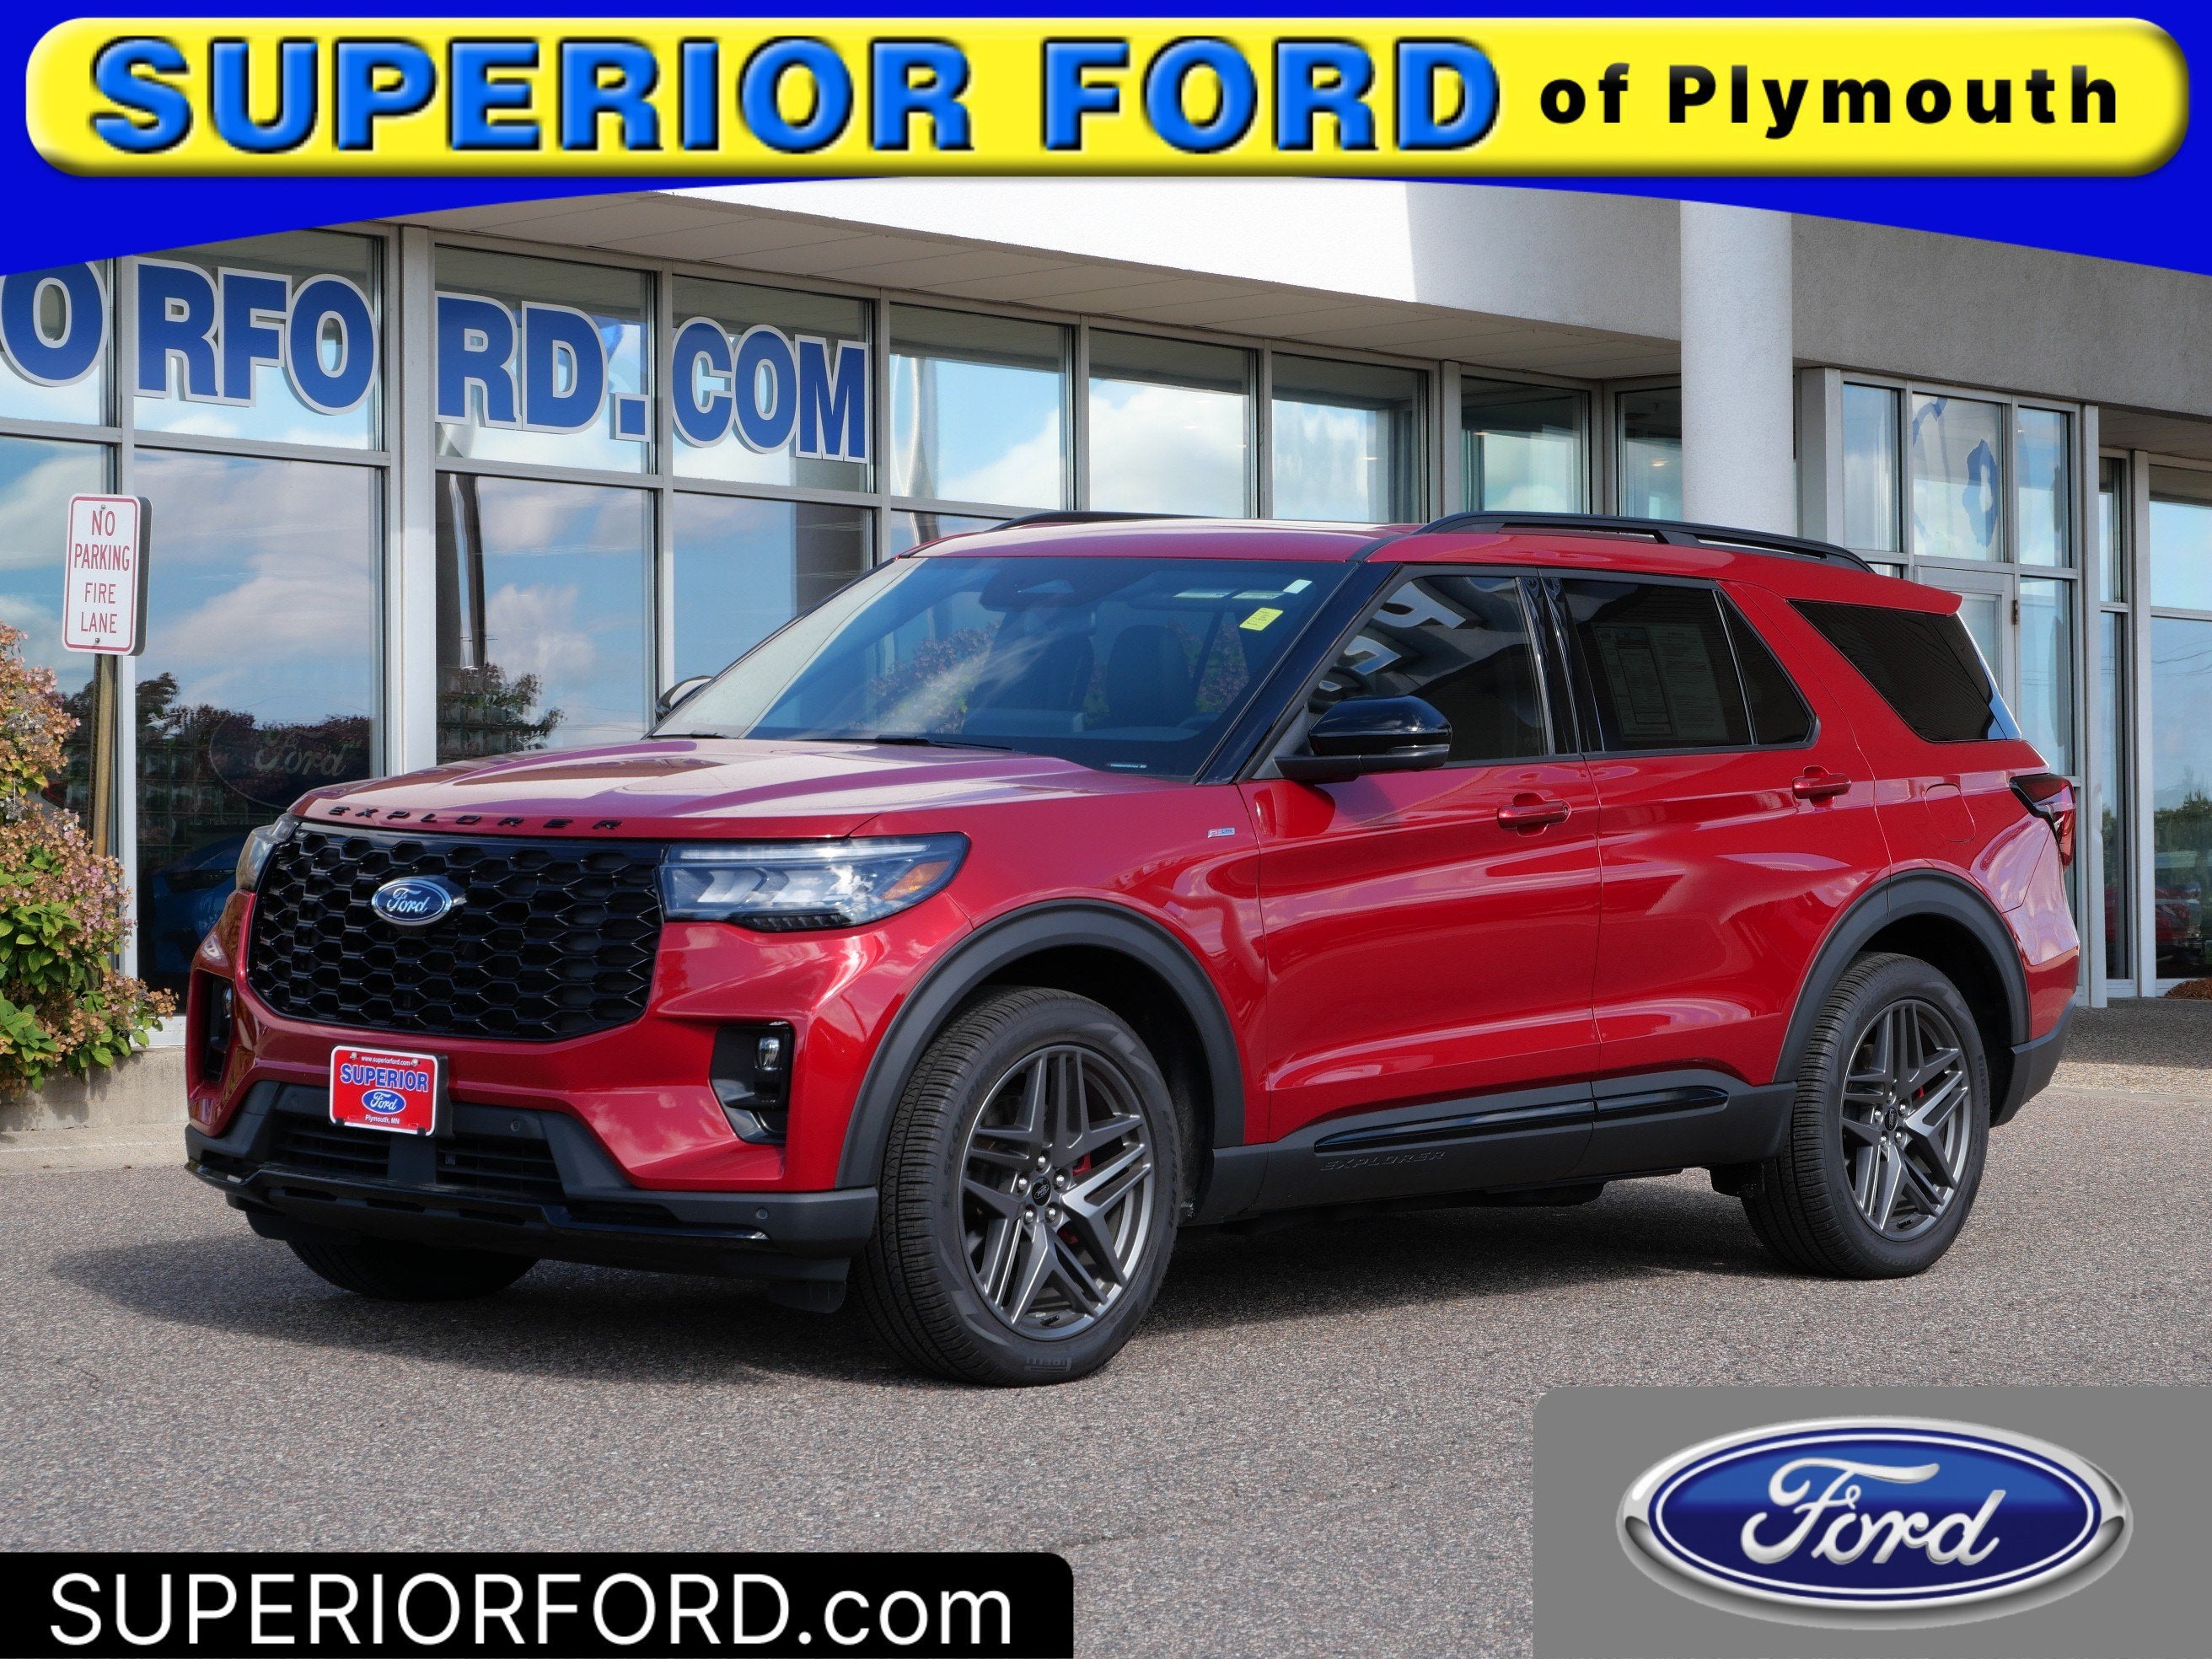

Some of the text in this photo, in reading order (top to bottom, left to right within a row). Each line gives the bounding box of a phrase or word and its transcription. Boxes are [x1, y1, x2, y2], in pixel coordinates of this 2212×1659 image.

[91, 510, 115, 537] NO
[74, 543, 131, 572] PARKING
[84, 582, 116, 604] FIRE
[80, 611, 118, 634] LANE
[253, 730, 347, 777] Ford
[328, 806, 622, 830] EXPLORER
[386, 888, 431, 914] Ford
[361, 1055, 411, 1066] www.superiorford.com
[341, 1063, 429, 1093] SUPERIOR
[370, 1092, 399, 1111] Ford
[365, 1114, 390, 1124] Plymouth,
[1320, 1152, 1446, 1172] EXPLORER
